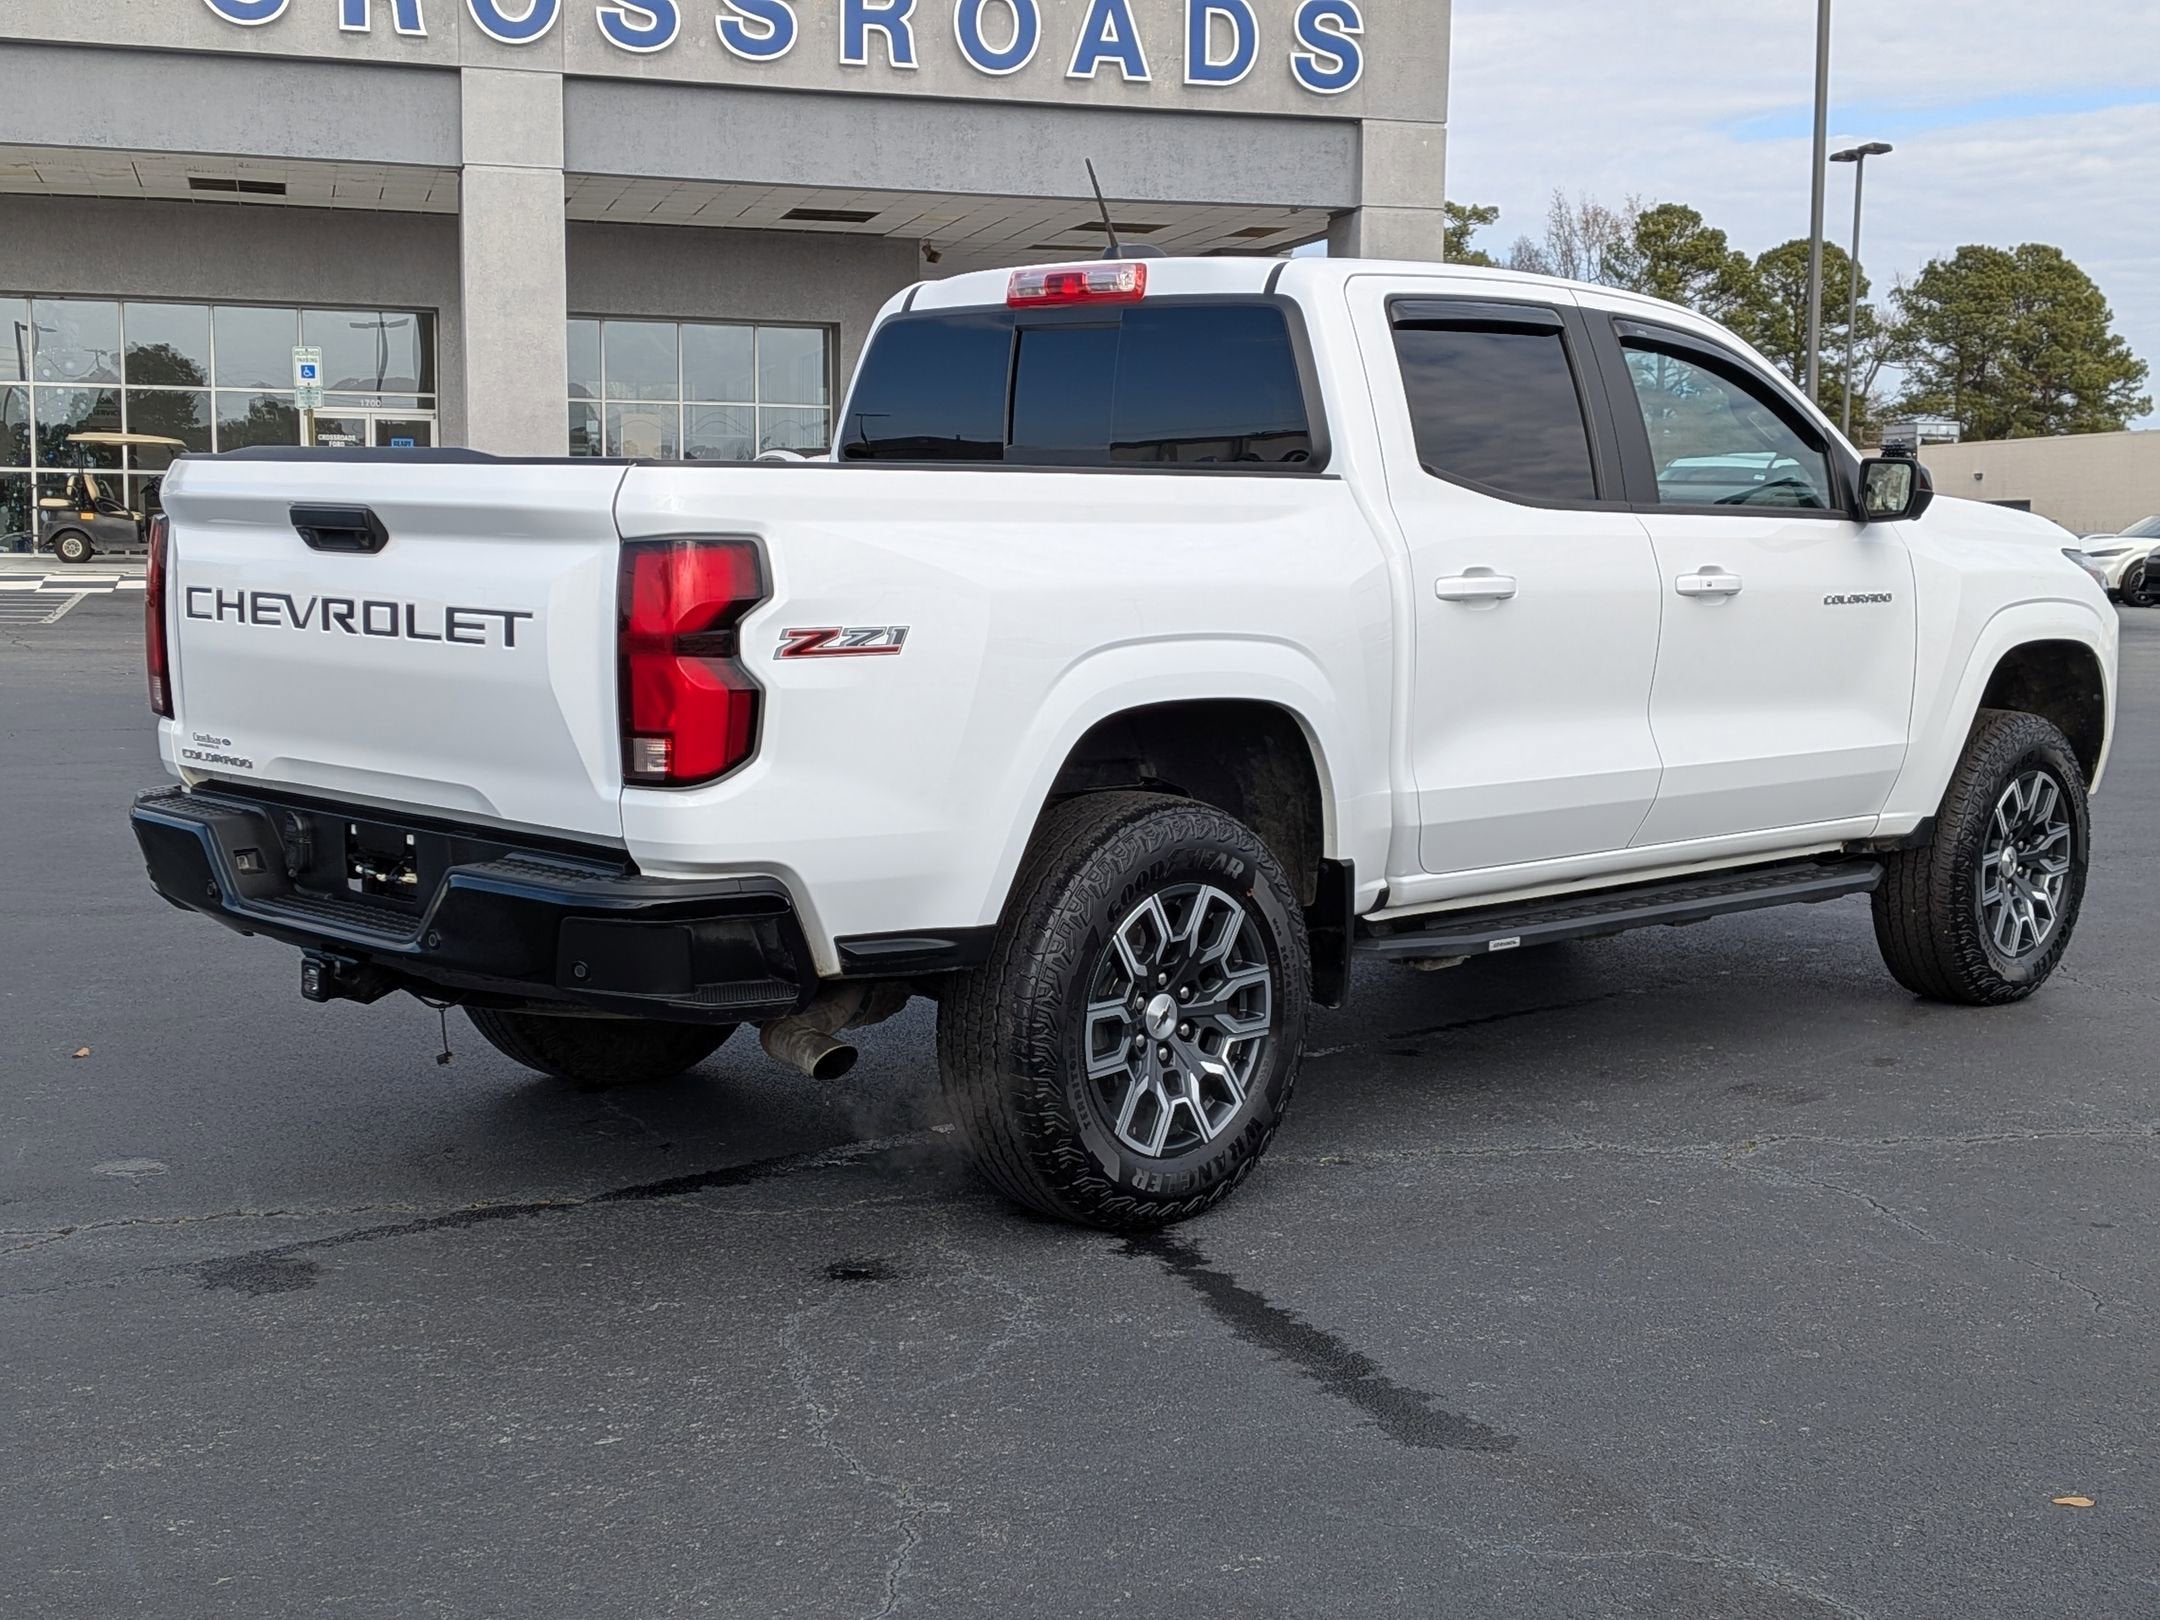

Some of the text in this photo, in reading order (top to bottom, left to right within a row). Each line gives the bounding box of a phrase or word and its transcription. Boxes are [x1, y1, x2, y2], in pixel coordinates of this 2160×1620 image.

[205, 0, 1365, 95] SSROADS
[360, 399, 383, 408] 1700
[317, 433, 357, 442] CROSSROADS
[328, 440, 346, 448] FORD
[1824, 592, 1893, 606] COLORADO
[186, 586, 533, 648] CHEVROLET
[773, 626, 911, 661] Z71
[181, 748, 254, 769] COLORADO
[1068, 1036, 1092, 1131] TERRITORY
[1131, 1116, 1264, 1194] WRANGLER
